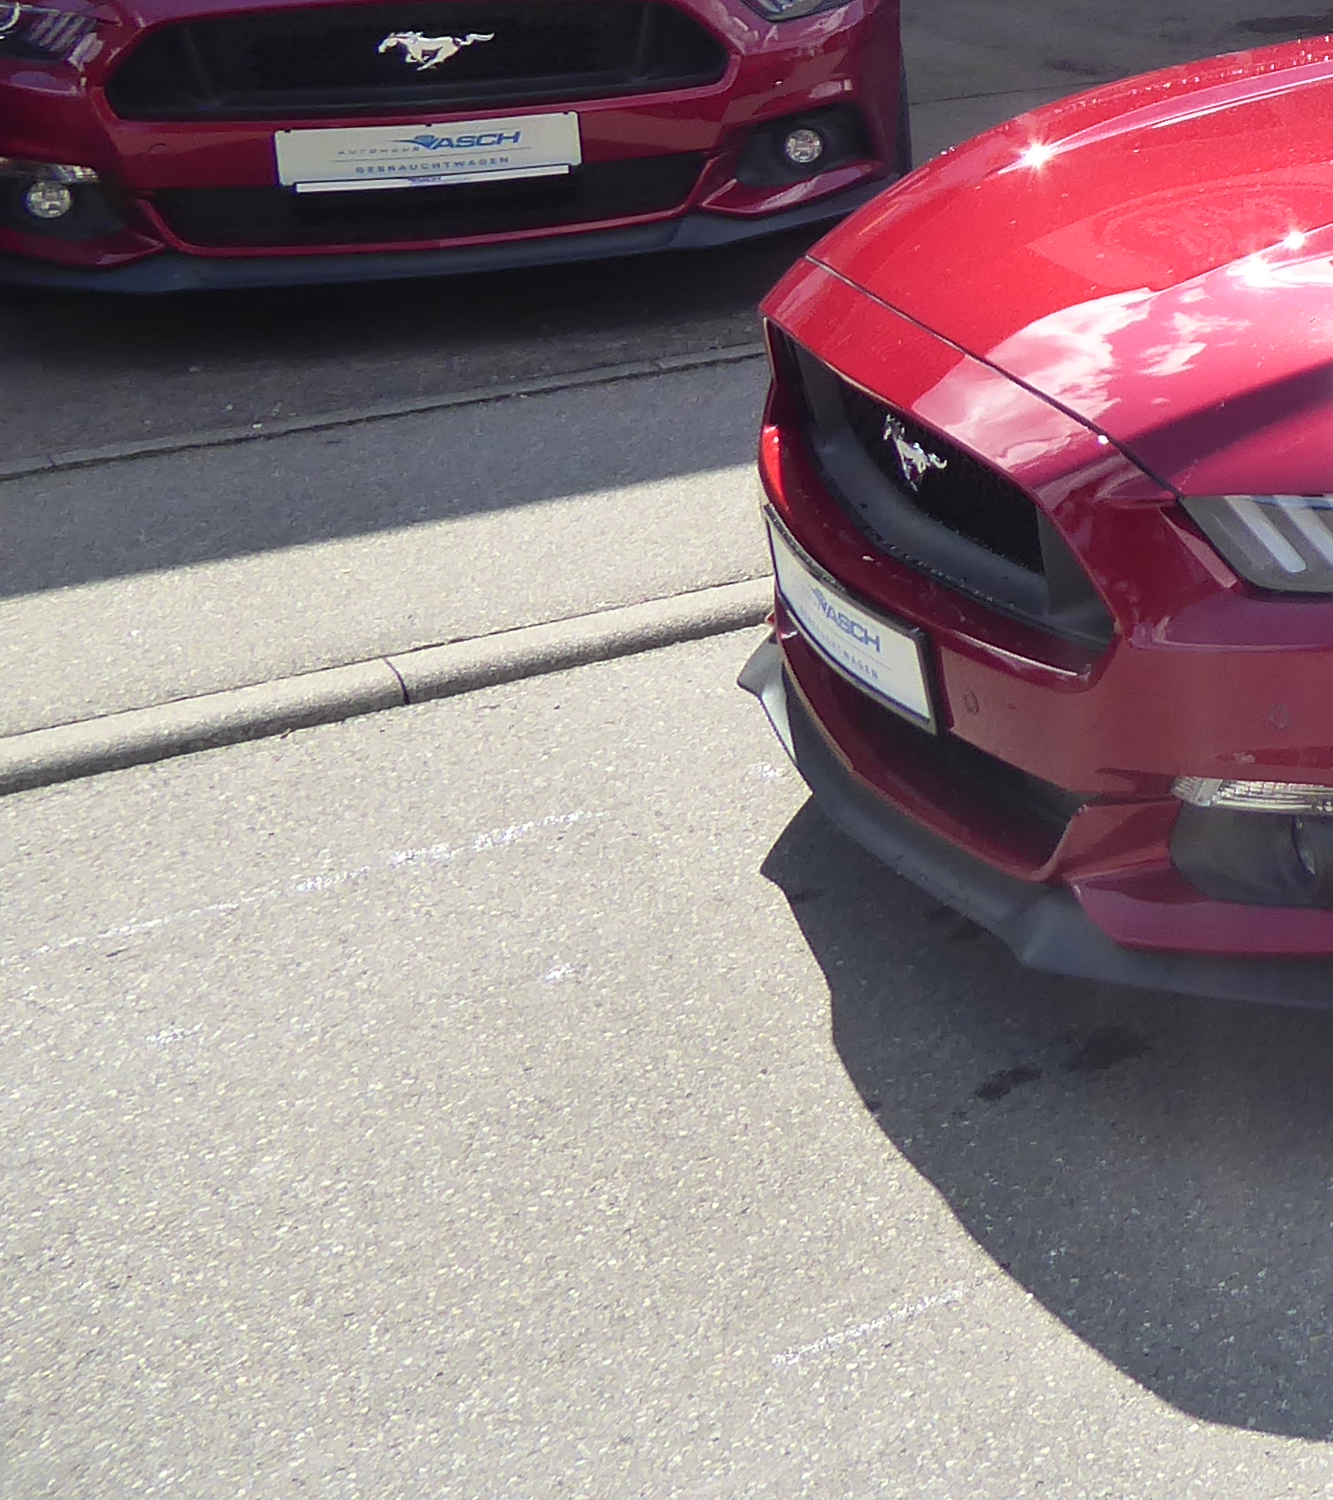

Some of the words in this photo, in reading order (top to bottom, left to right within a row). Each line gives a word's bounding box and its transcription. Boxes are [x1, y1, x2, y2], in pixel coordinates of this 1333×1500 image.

[432, 130, 522, 150] ASCH
[355, 156, 510, 175] GEBRAUCHTWAGEN
[824, 607, 881, 653] ASCH
